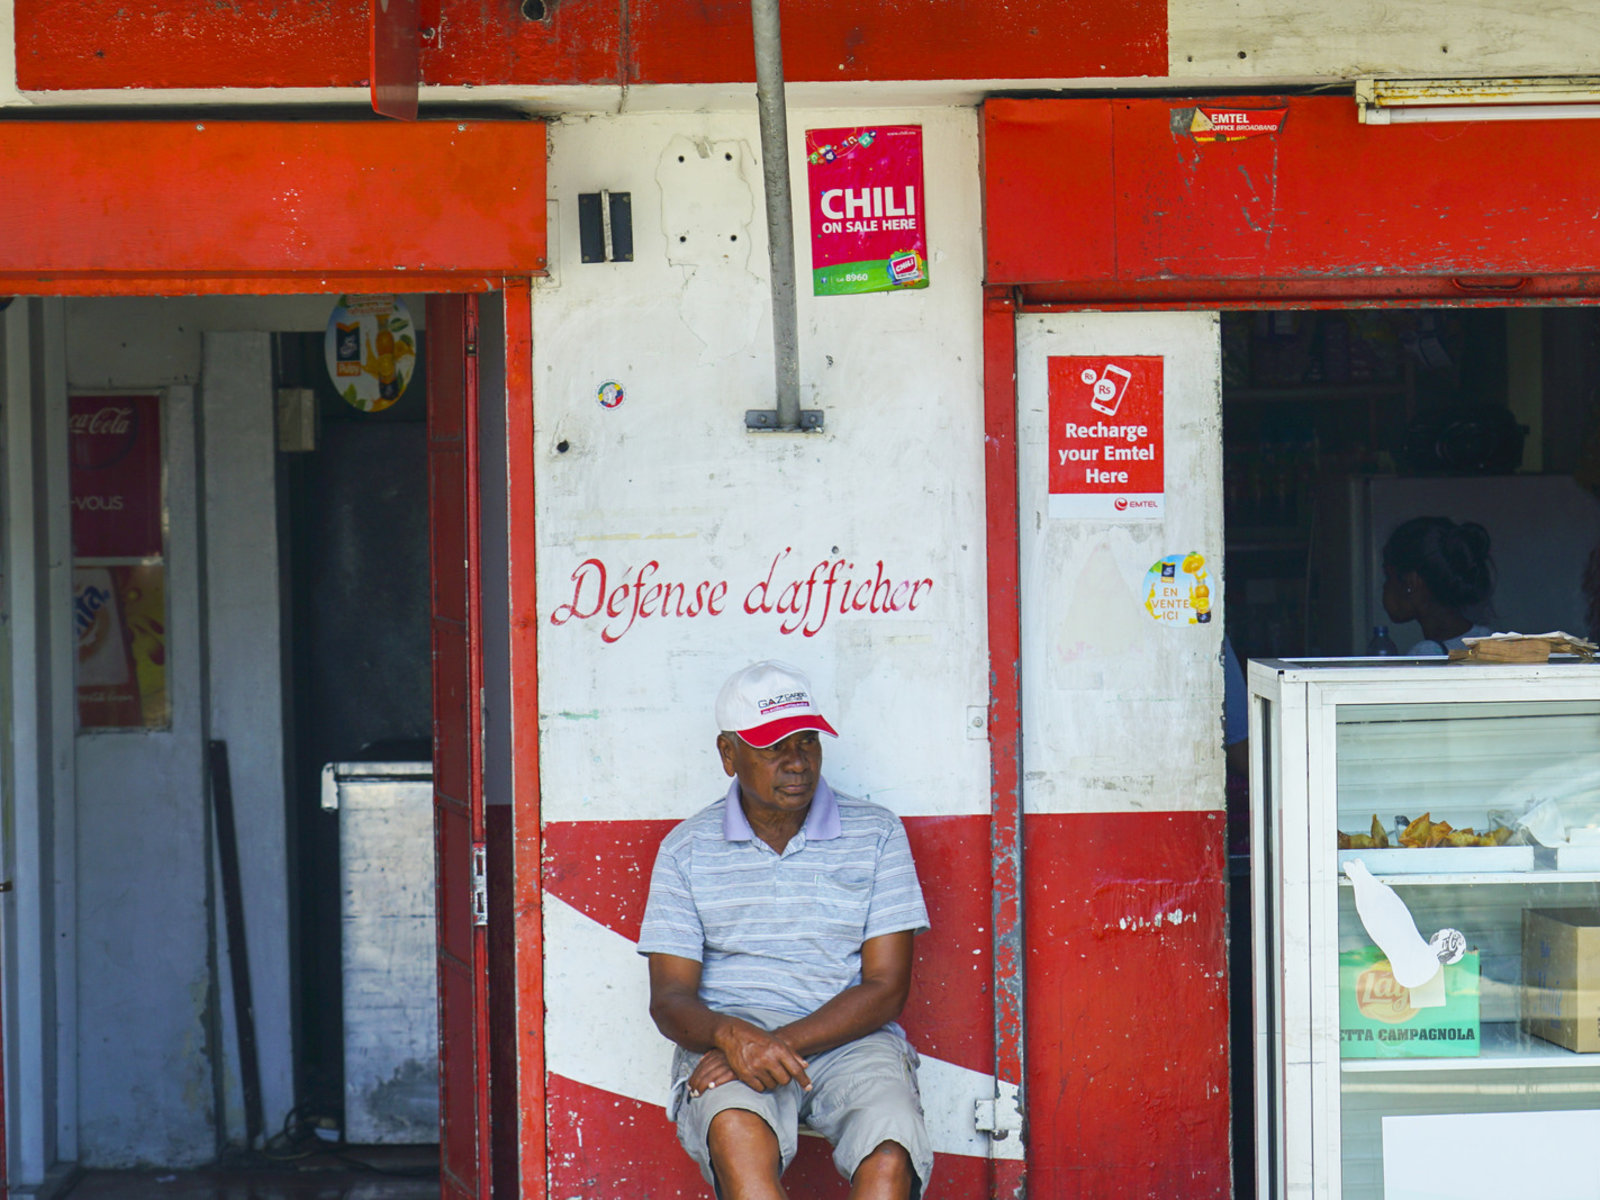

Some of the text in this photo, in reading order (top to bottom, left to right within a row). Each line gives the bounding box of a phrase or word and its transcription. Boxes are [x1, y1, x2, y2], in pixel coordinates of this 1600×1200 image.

[1211, 113, 1249, 124] EMTEL
[820, 185, 916, 220] CHILI
[821, 218, 917, 234] ON SALE HERE
[845, 273, 868, 282] 8960
[1084, 372, 1094, 380] Rs
[1099, 384, 1111, 395] Rs
[1065, 421, 1148, 442] Recharge
[1058, 443, 1155, 466] your Emtel
[1085, 468, 1129, 484] Here
[550, 546, 933, 644] Défense d'afficher
[1163, 587, 1178, 597] EN
[1151, 599, 1190, 609] VENTE
[1162, 610, 1178, 620] ICI
[758, 695, 784, 709] GAZ
[1377, 1027, 1476, 1041] CAMPAGNOLA
